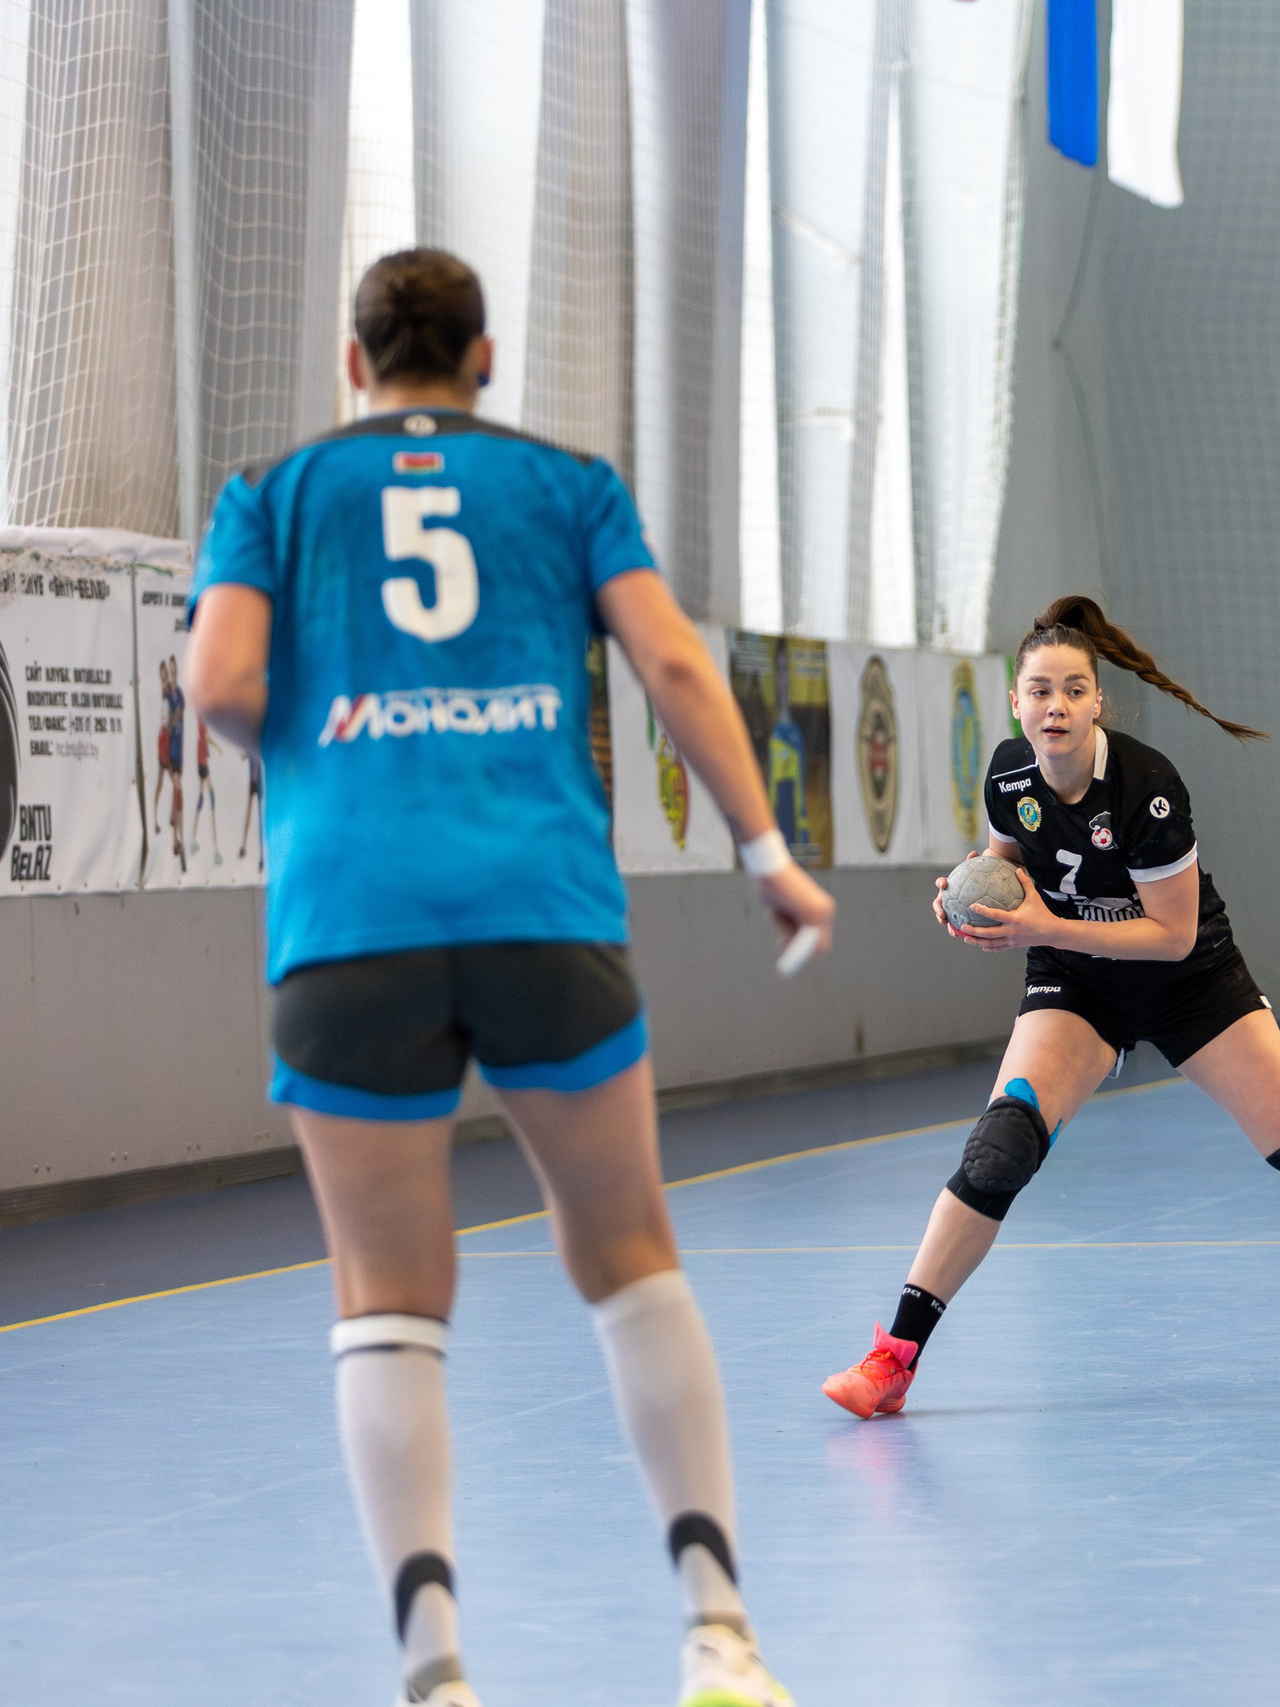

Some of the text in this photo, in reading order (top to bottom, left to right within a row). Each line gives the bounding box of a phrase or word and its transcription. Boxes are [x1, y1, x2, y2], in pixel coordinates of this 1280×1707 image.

[381, 486, 480, 643] 5
[998, 778, 1032, 793] Kempa
[19, 804, 52, 842] BNTU
[1056, 849, 1083, 895] 7
